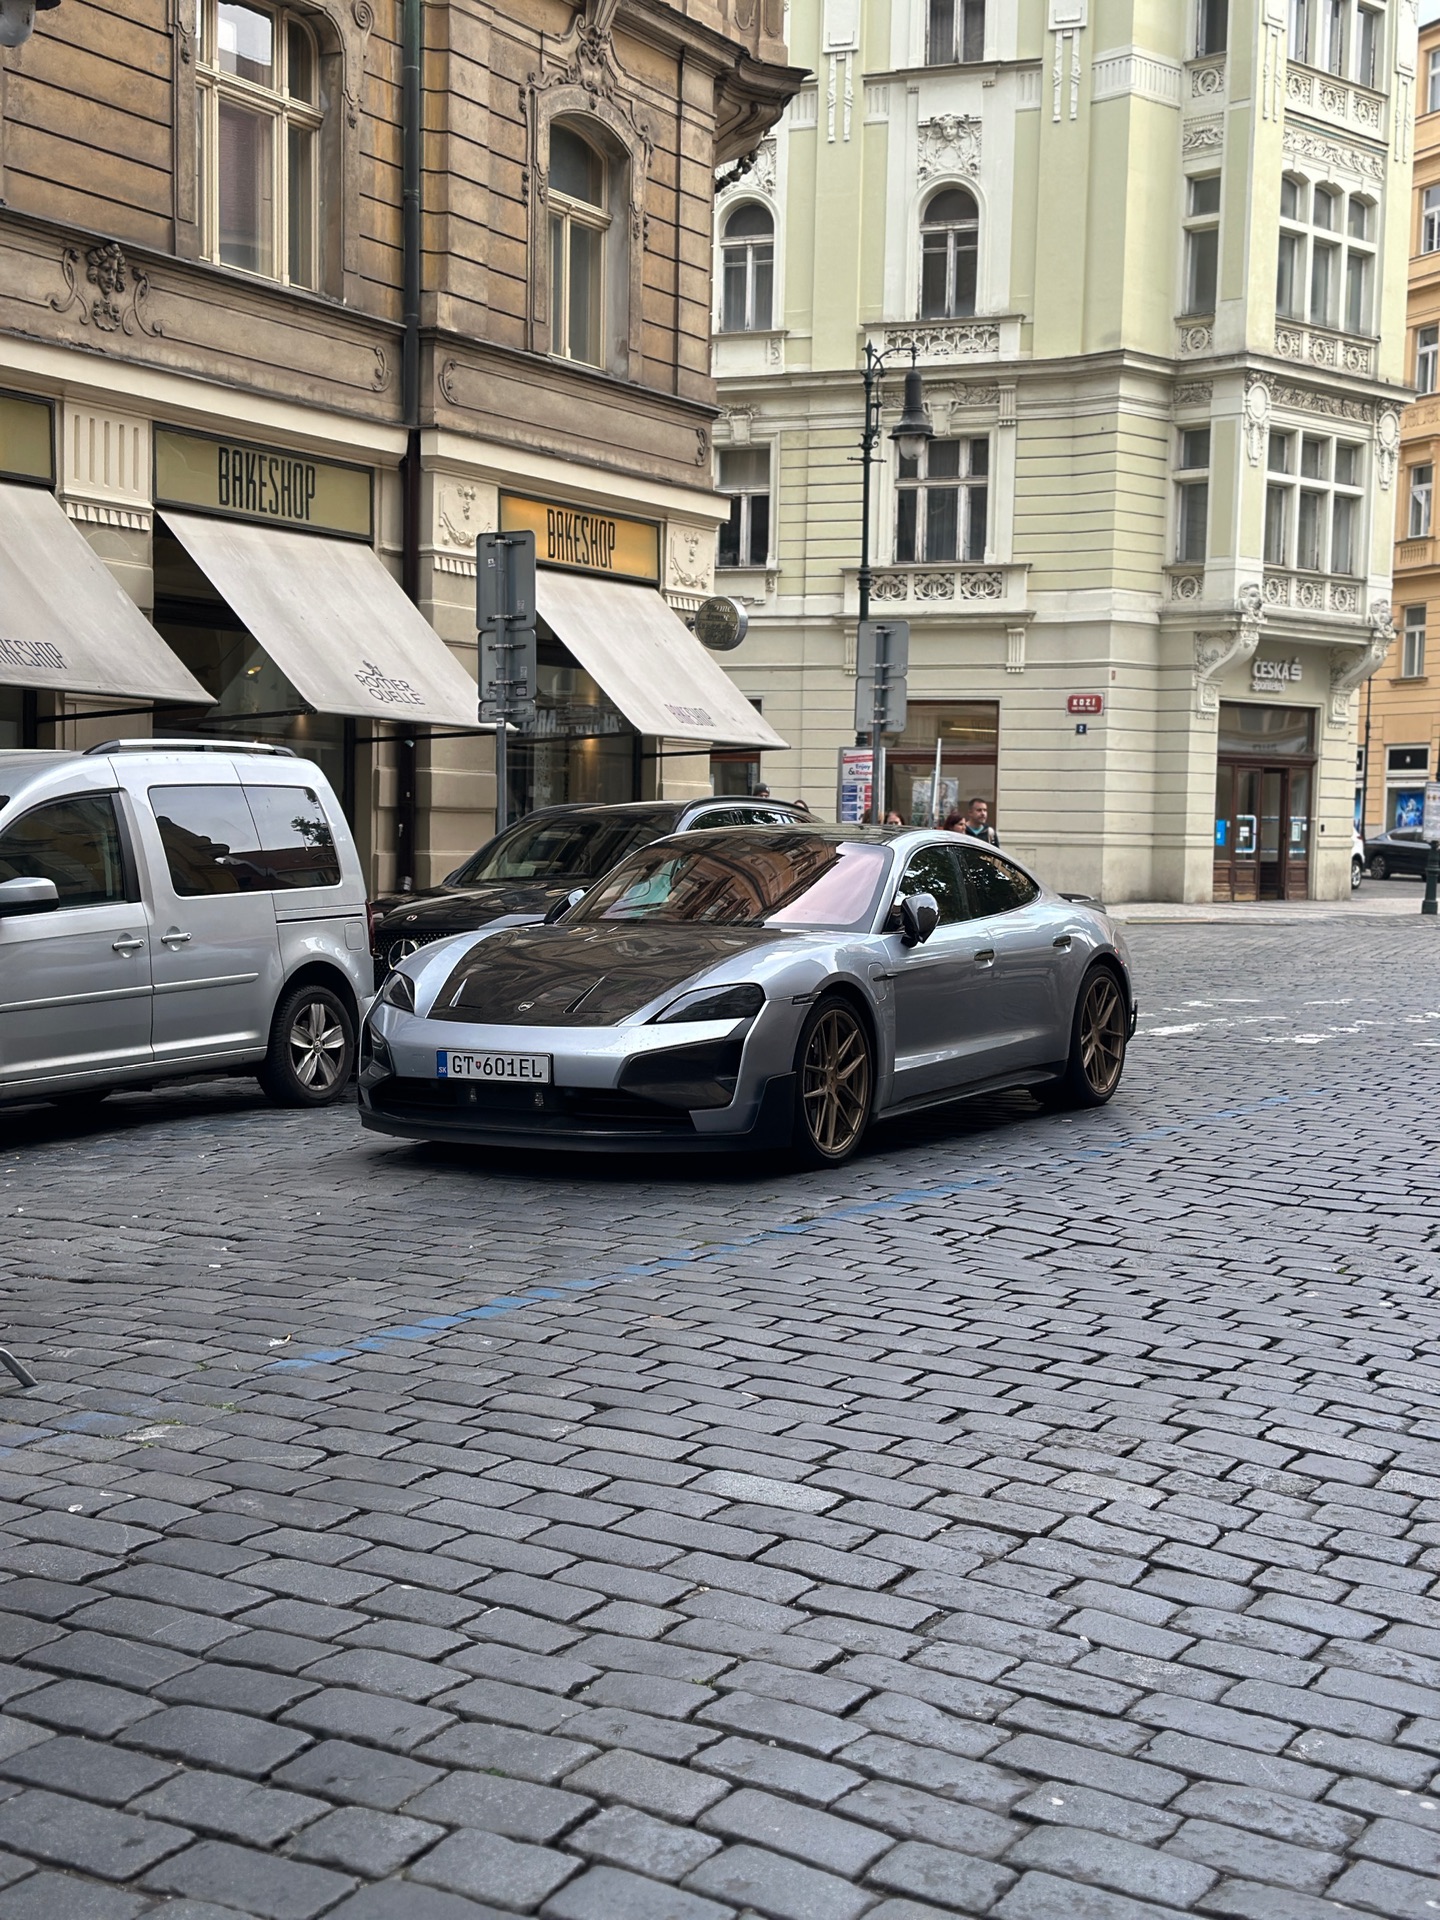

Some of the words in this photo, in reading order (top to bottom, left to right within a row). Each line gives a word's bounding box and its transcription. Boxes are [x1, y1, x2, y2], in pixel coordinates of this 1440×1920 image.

[218, 446, 315, 521] BAKESHOP
[547, 508, 616, 570] BAKESHOP
[0, 639, 68, 670] KESHOP
[1254, 656, 1290, 680] ČESKÁ
[369, 688, 426, 706] QUELLE
[855, 763, 871, 771] Enjoy
[438, 1066, 447, 1074] SK
[452, 1055, 474, 1075] GT
[482, 1057, 543, 1078] 601EL
